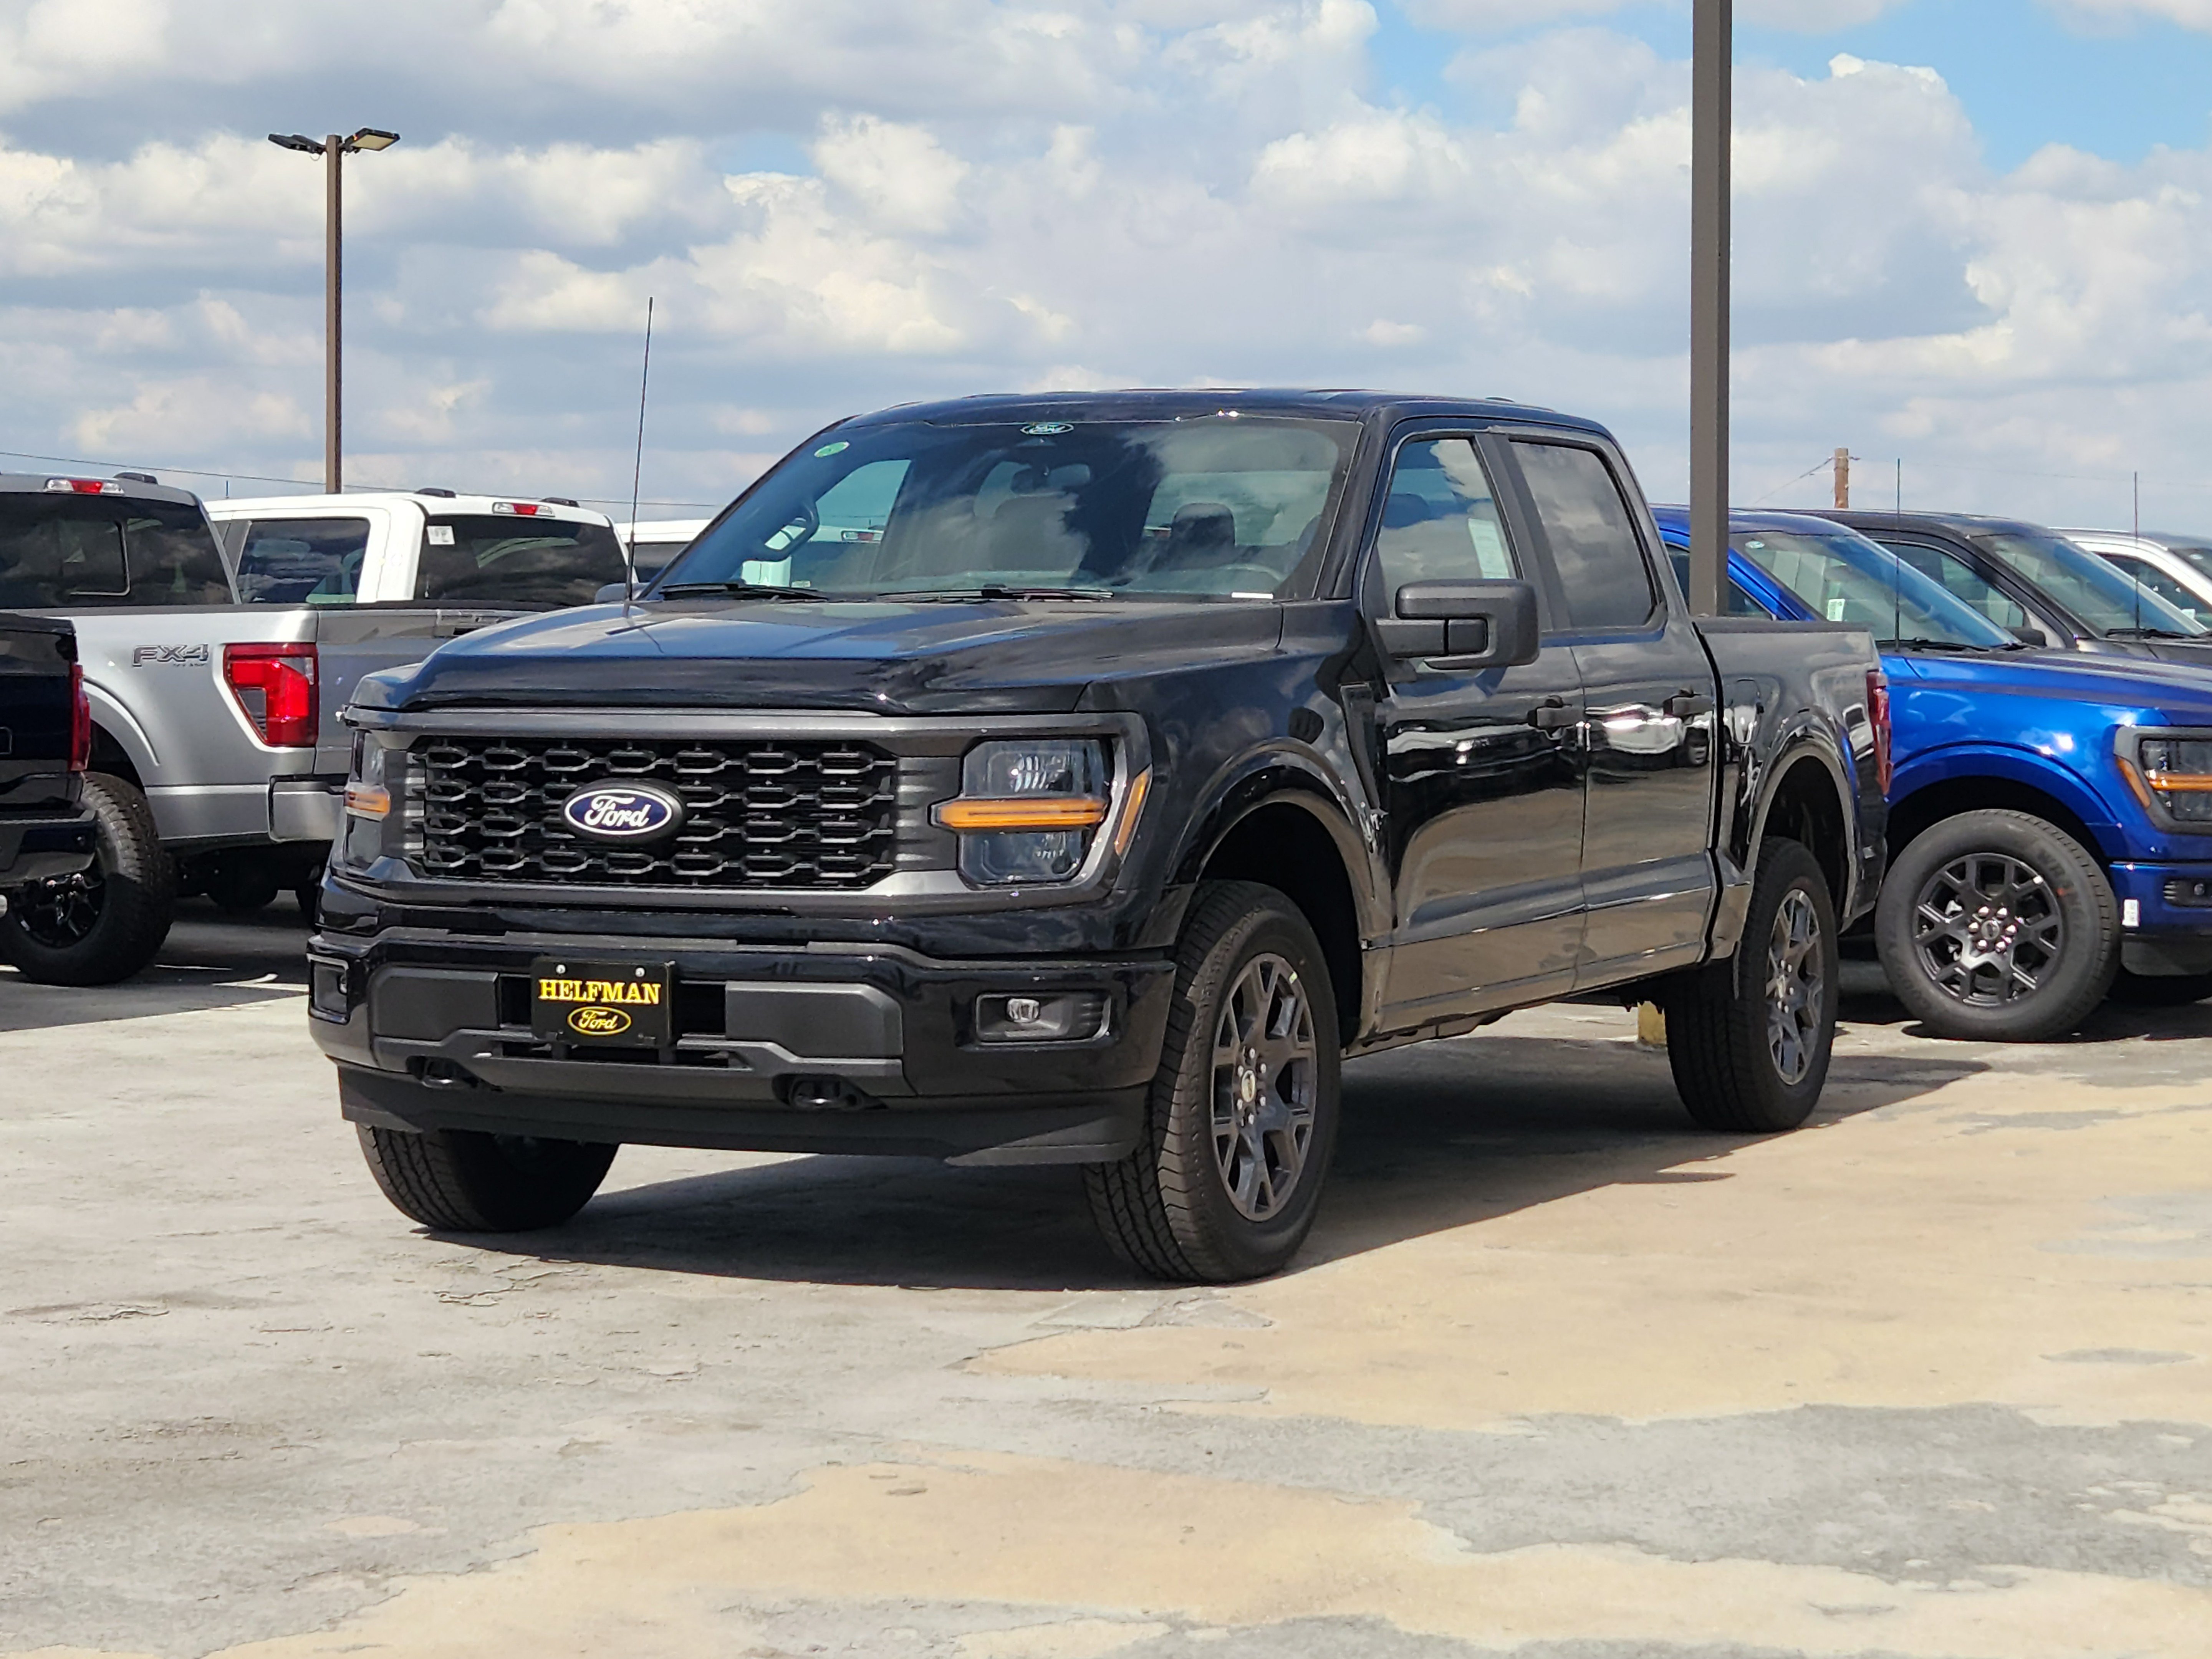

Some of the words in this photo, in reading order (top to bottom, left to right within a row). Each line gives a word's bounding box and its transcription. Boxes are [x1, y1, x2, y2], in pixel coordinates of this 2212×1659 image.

[132, 644, 209, 667] FX4
[584, 795, 651, 827] Ford
[538, 979, 661, 1004] HELFMAN
[578, 1010, 618, 1030] Ford
